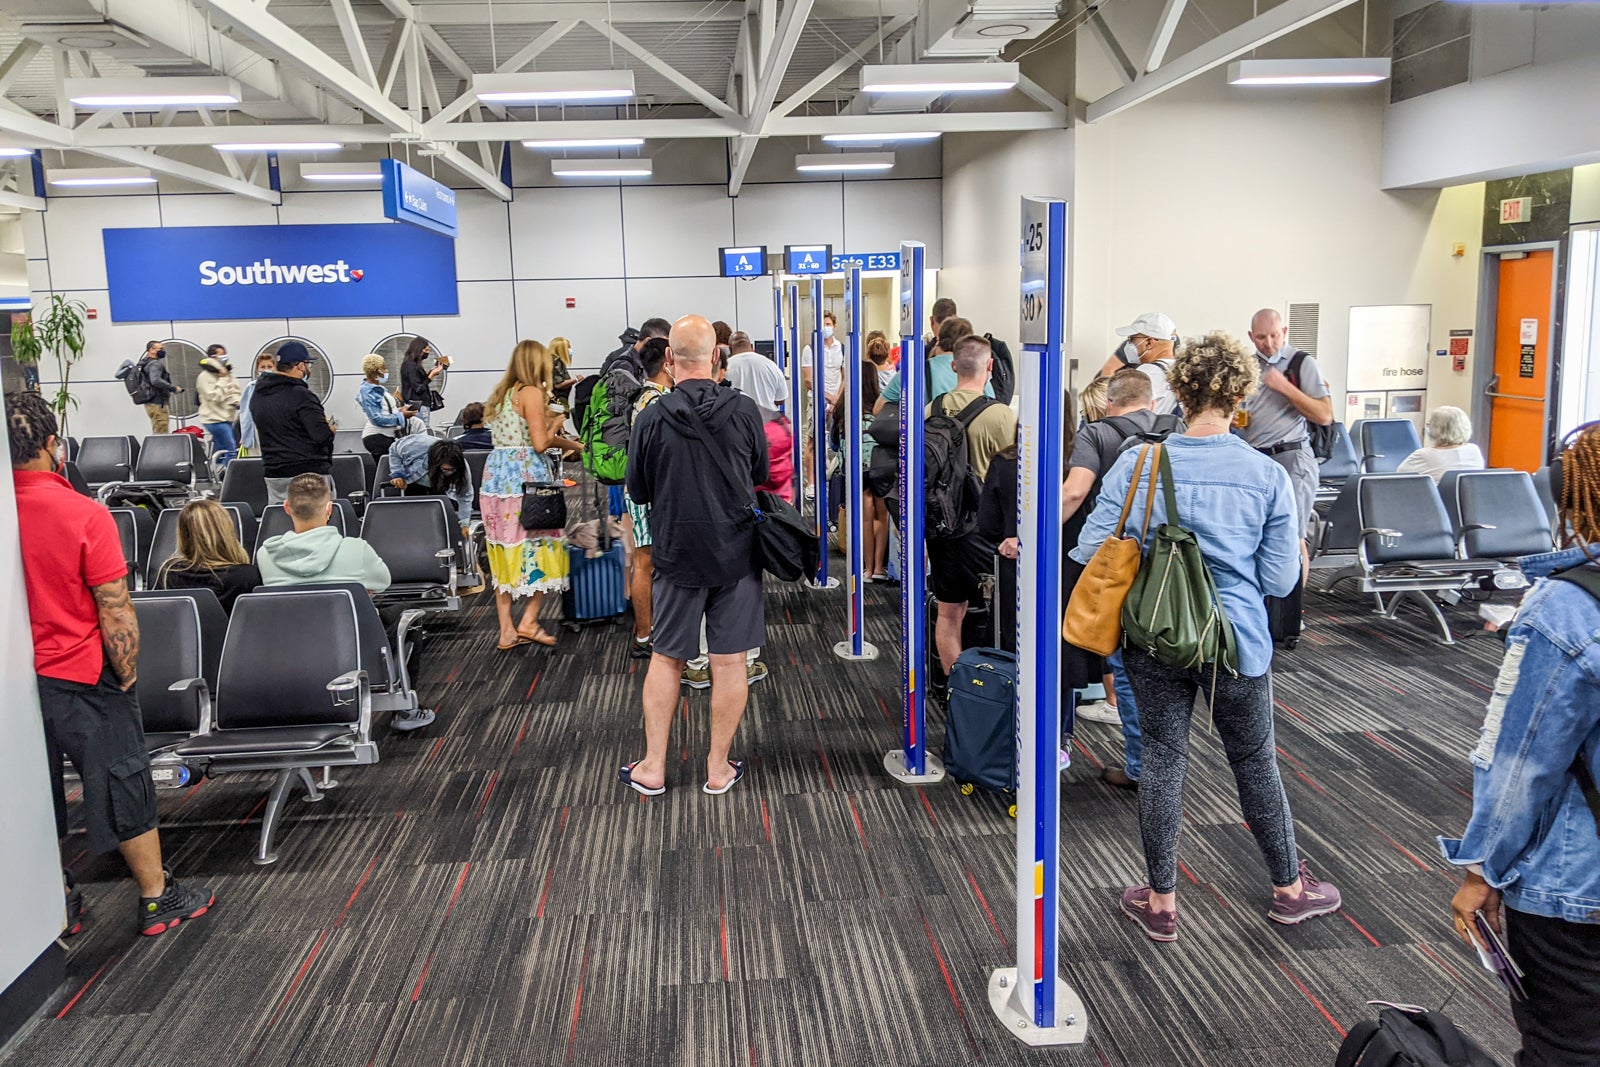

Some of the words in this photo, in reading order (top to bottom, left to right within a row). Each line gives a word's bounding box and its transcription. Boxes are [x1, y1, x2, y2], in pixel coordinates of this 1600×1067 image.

[1503, 201, 1520, 221] EXIT
[739, 255, 748, 265] A
[804, 253, 813, 263] A
[868, 255, 896, 269] E33
[199, 258, 351, 286] Southwest
[1382, 367, 1398, 377] fire
[1400, 367, 1424, 376] hose
[1023, 424, 1031, 485] thanks!
